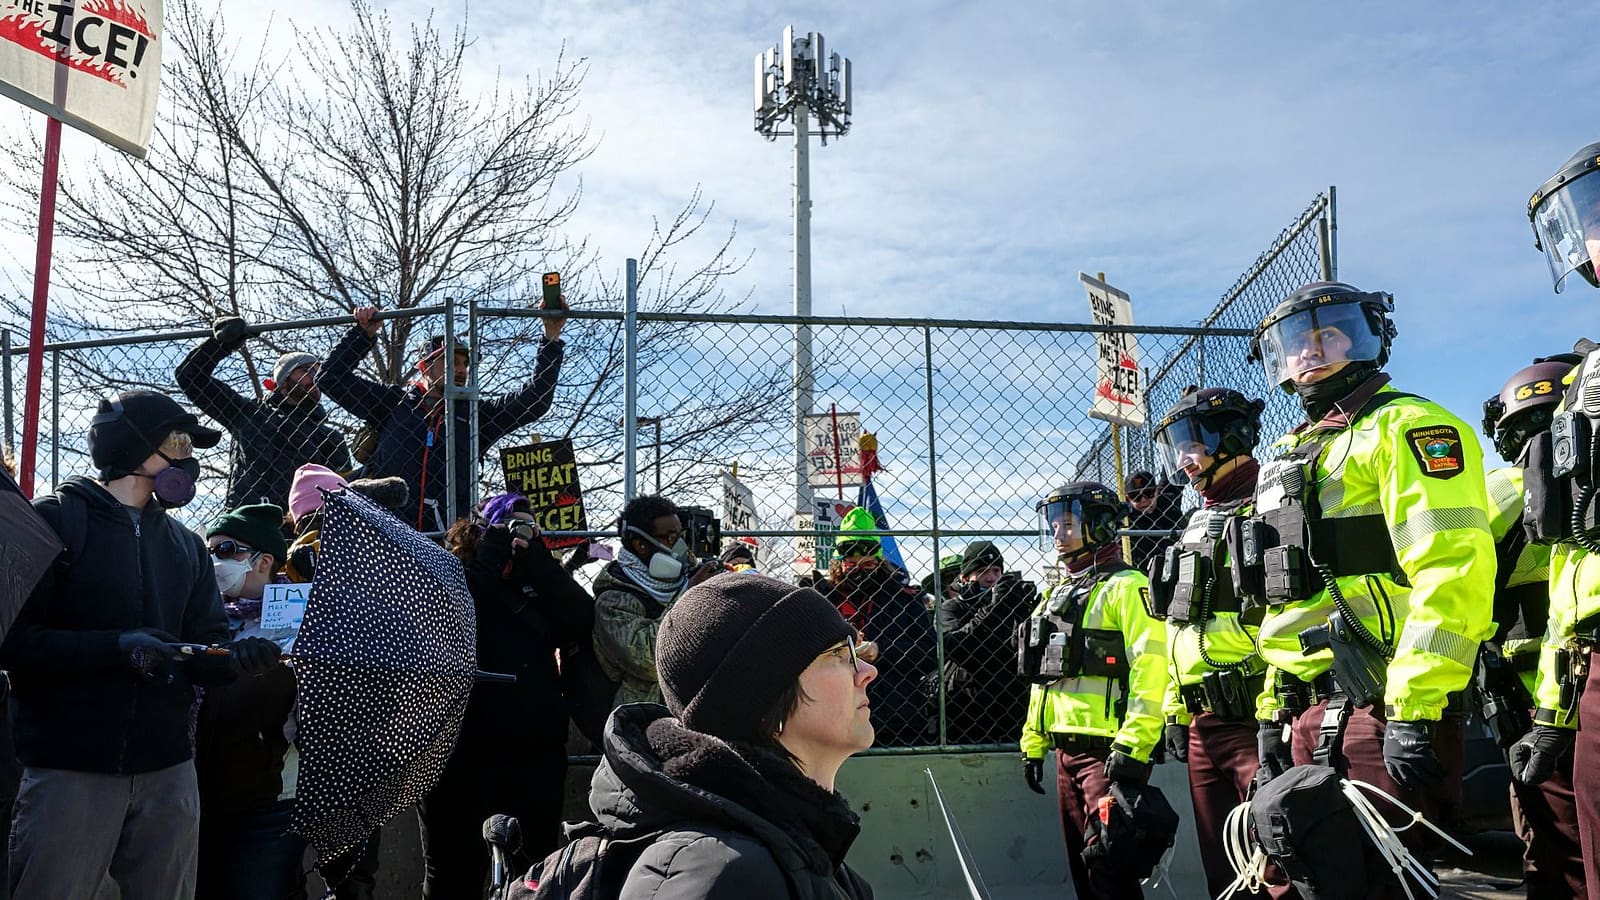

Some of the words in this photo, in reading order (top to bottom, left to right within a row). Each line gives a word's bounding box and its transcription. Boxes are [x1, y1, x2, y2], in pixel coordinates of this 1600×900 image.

[40, 3, 149, 79] ICE!
[1089, 292, 1115, 319] BRING
[1113, 366, 1138, 398] ICE!
[1516, 381, 1553, 400] 63
[1412, 428, 1454, 439] MINNESOTA
[507, 448, 552, 469] BRING
[507, 471, 521, 481] THE
[523, 463, 575, 491] HEAT
[528, 490, 559, 510] ELT
[817, 502, 831, 521] I
